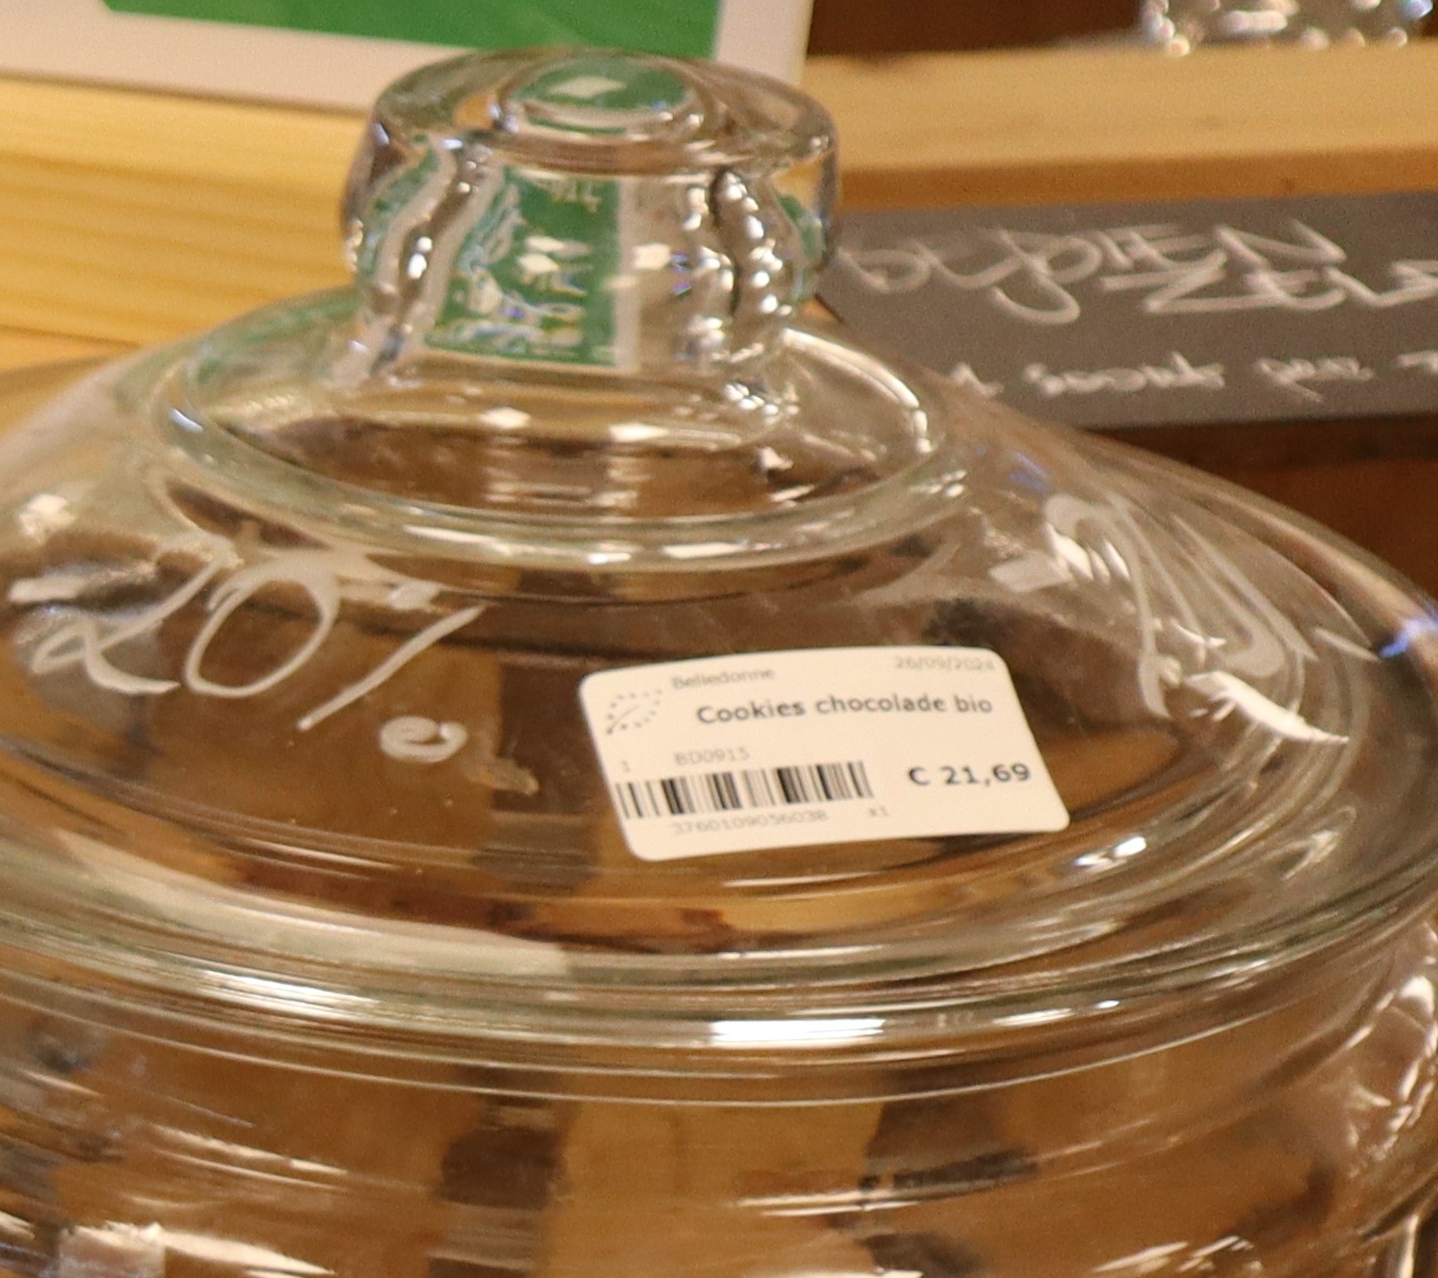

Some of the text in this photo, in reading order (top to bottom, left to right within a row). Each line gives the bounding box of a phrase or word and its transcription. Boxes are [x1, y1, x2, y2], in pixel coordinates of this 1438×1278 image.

[671, 668, 776, 690] Belledonne
[696, 693, 993, 725] Cookies chocolade bio
[673, 746, 750, 766] BD0915
[941, 762, 1031, 788] 21,69
